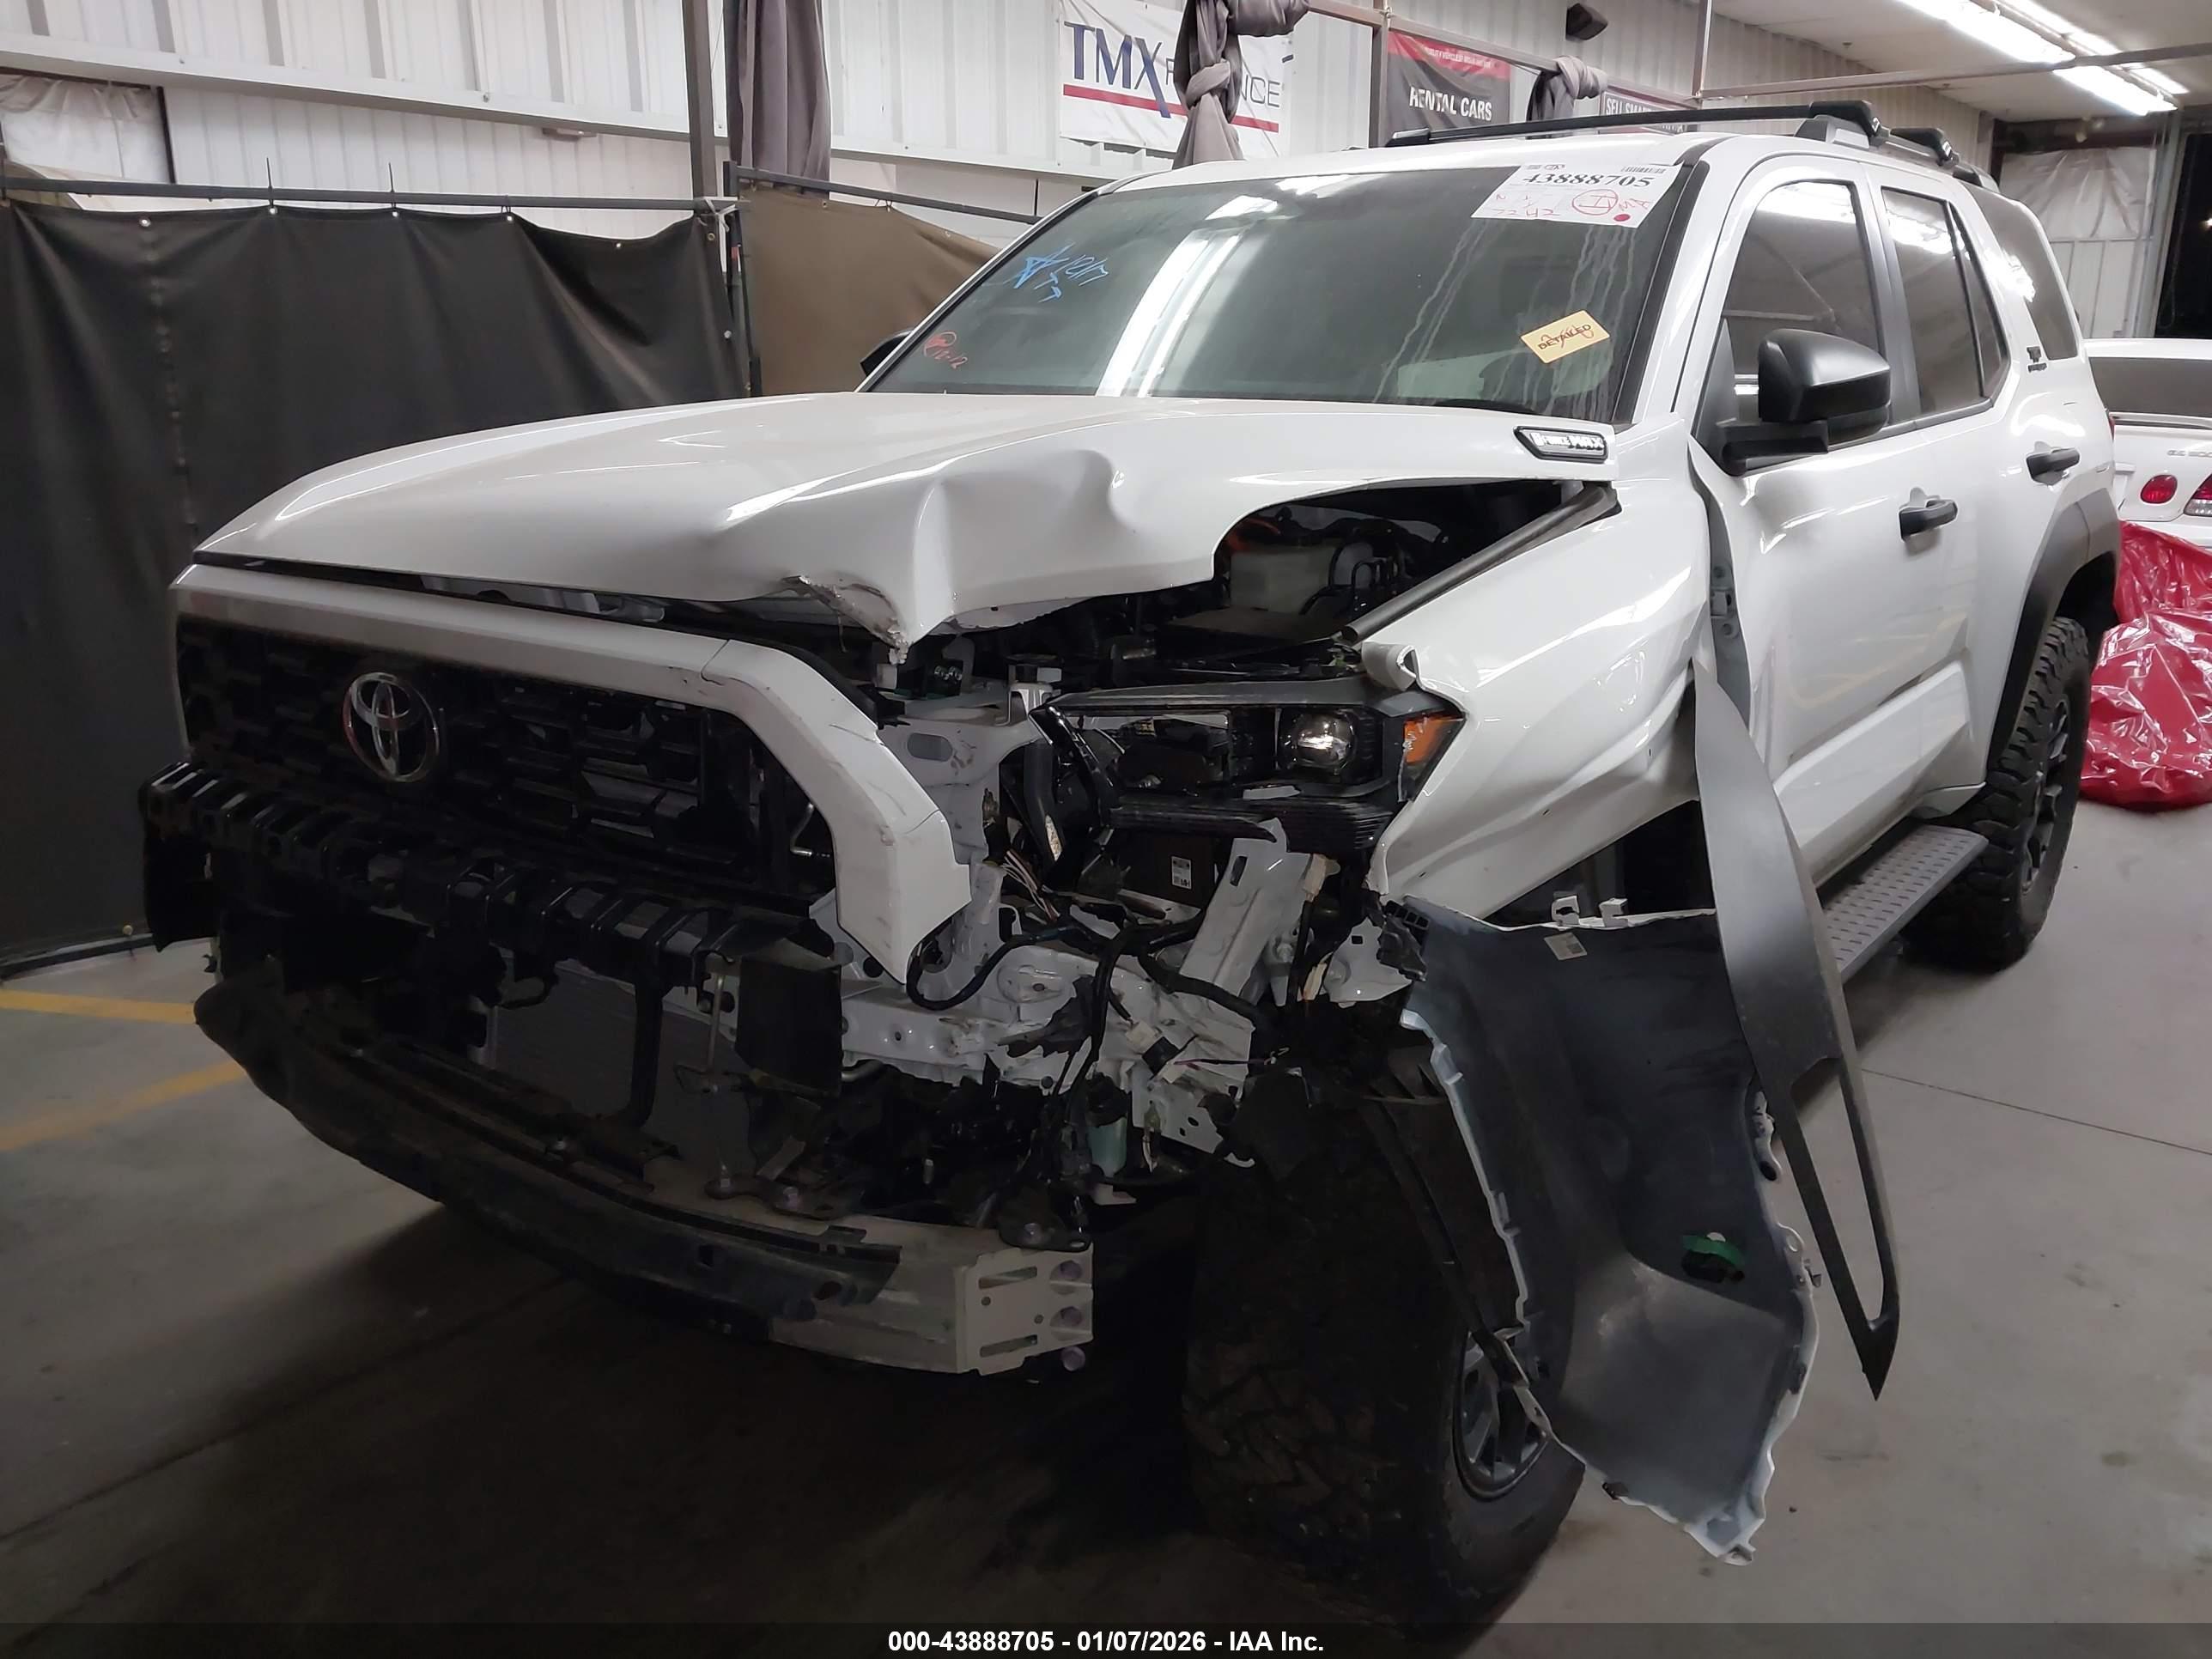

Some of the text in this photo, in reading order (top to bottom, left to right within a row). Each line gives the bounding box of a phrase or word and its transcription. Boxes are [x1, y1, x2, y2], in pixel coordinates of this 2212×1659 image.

[1064, 21, 1171, 118] TMX
[1409, 86, 1492, 121] RENTAL CARS
[1522, 173, 1655, 187] 43888705
[1538, 324, 1592, 350] DETAILED
